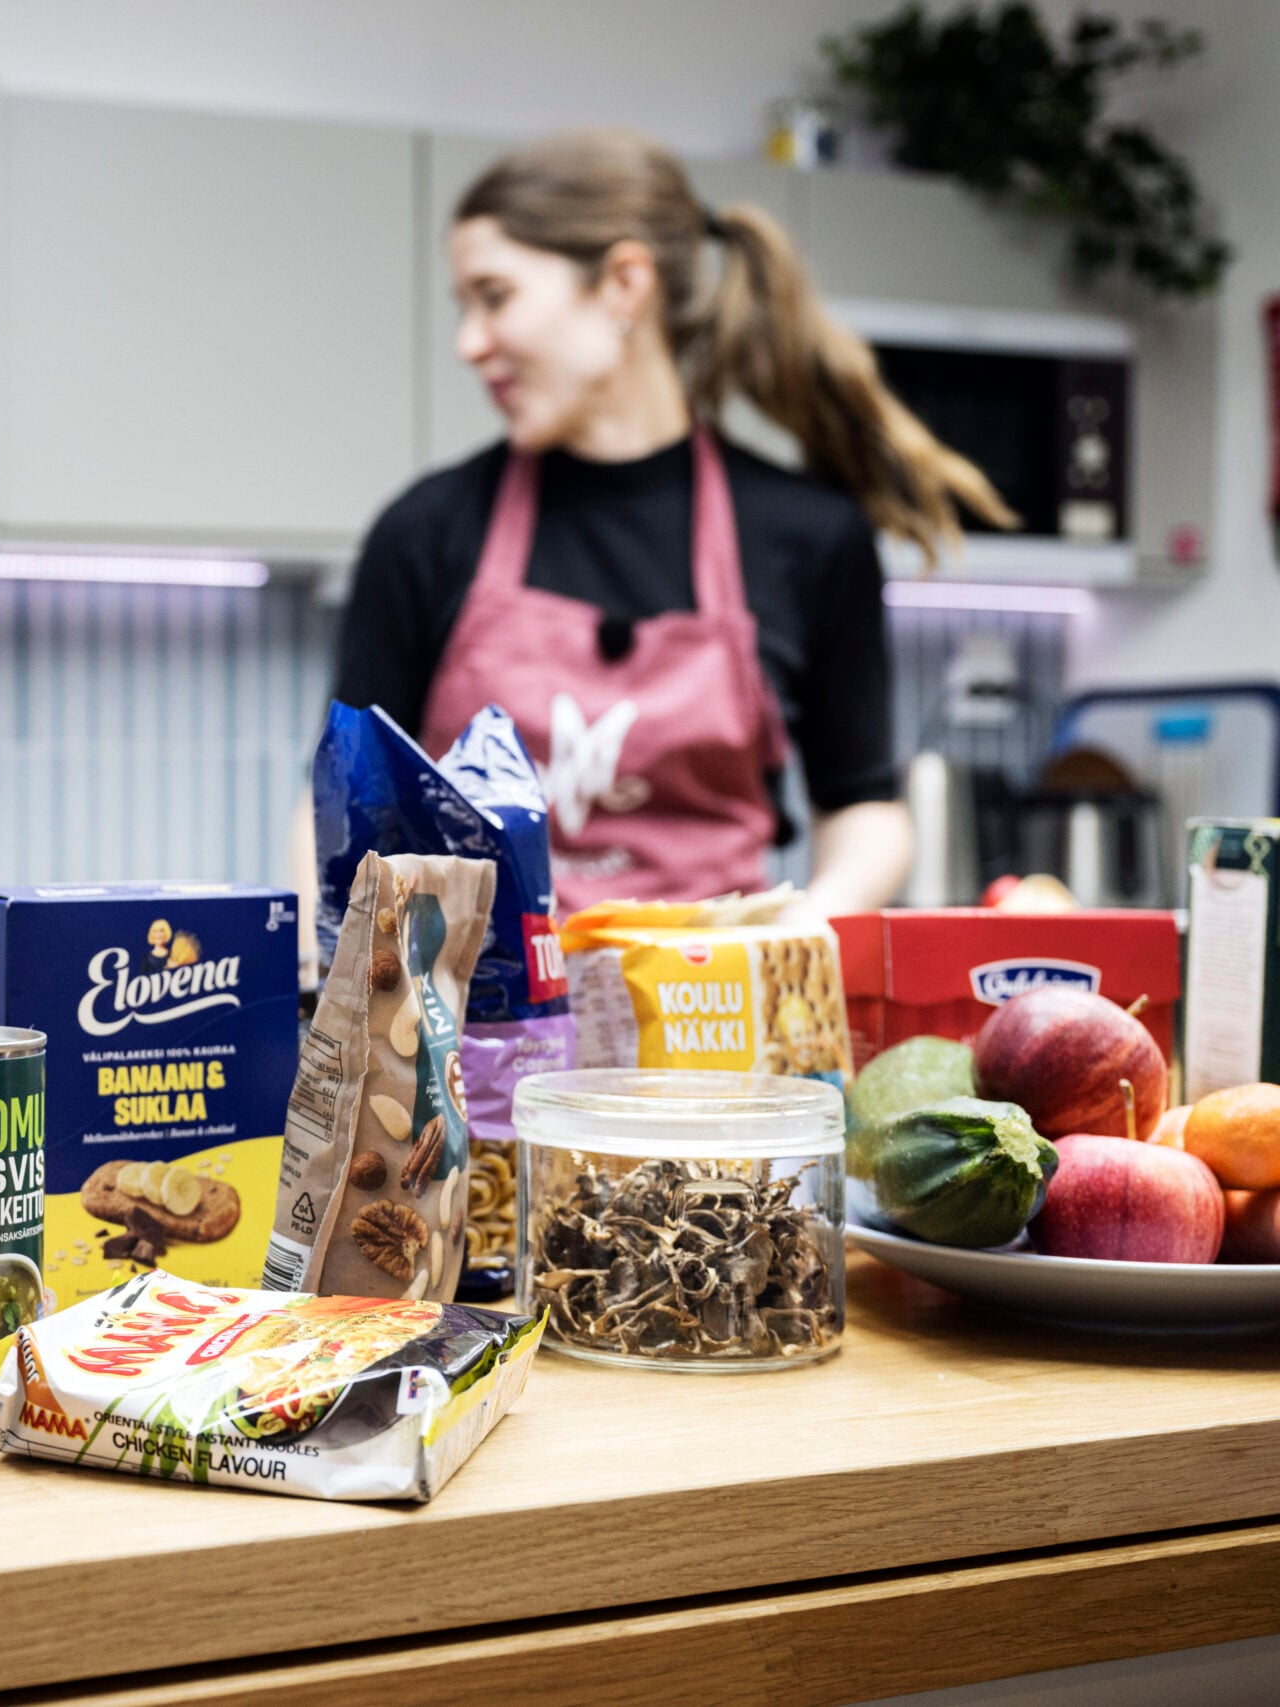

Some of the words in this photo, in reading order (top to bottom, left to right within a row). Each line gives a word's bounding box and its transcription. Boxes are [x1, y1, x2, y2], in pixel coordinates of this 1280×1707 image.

[78, 947, 241, 1036] Elovena
[421, 971, 454, 1036] MIX
[657, 981, 744, 1016] KOULU
[663, 1016, 746, 1056] NÄKKI
[97, 1062, 204, 1096] BANAANI
[206, 1060, 225, 1089] &
[114, 1092, 208, 1126] SUKLAA
[291, 1219, 313, 1236] PE-LD
[19, 1401, 89, 1442] MAMA
[94, 1411, 152, 1433] ORIENTAL
[155, 1423, 193, 1442] STYLE
[196, 1431, 254, 1449] INSTANT
[255, 1440, 320, 1458] NOODLES
[112, 1432, 192, 1464] CHICKEN
[197, 1450, 287, 1481] FLAVOUR
